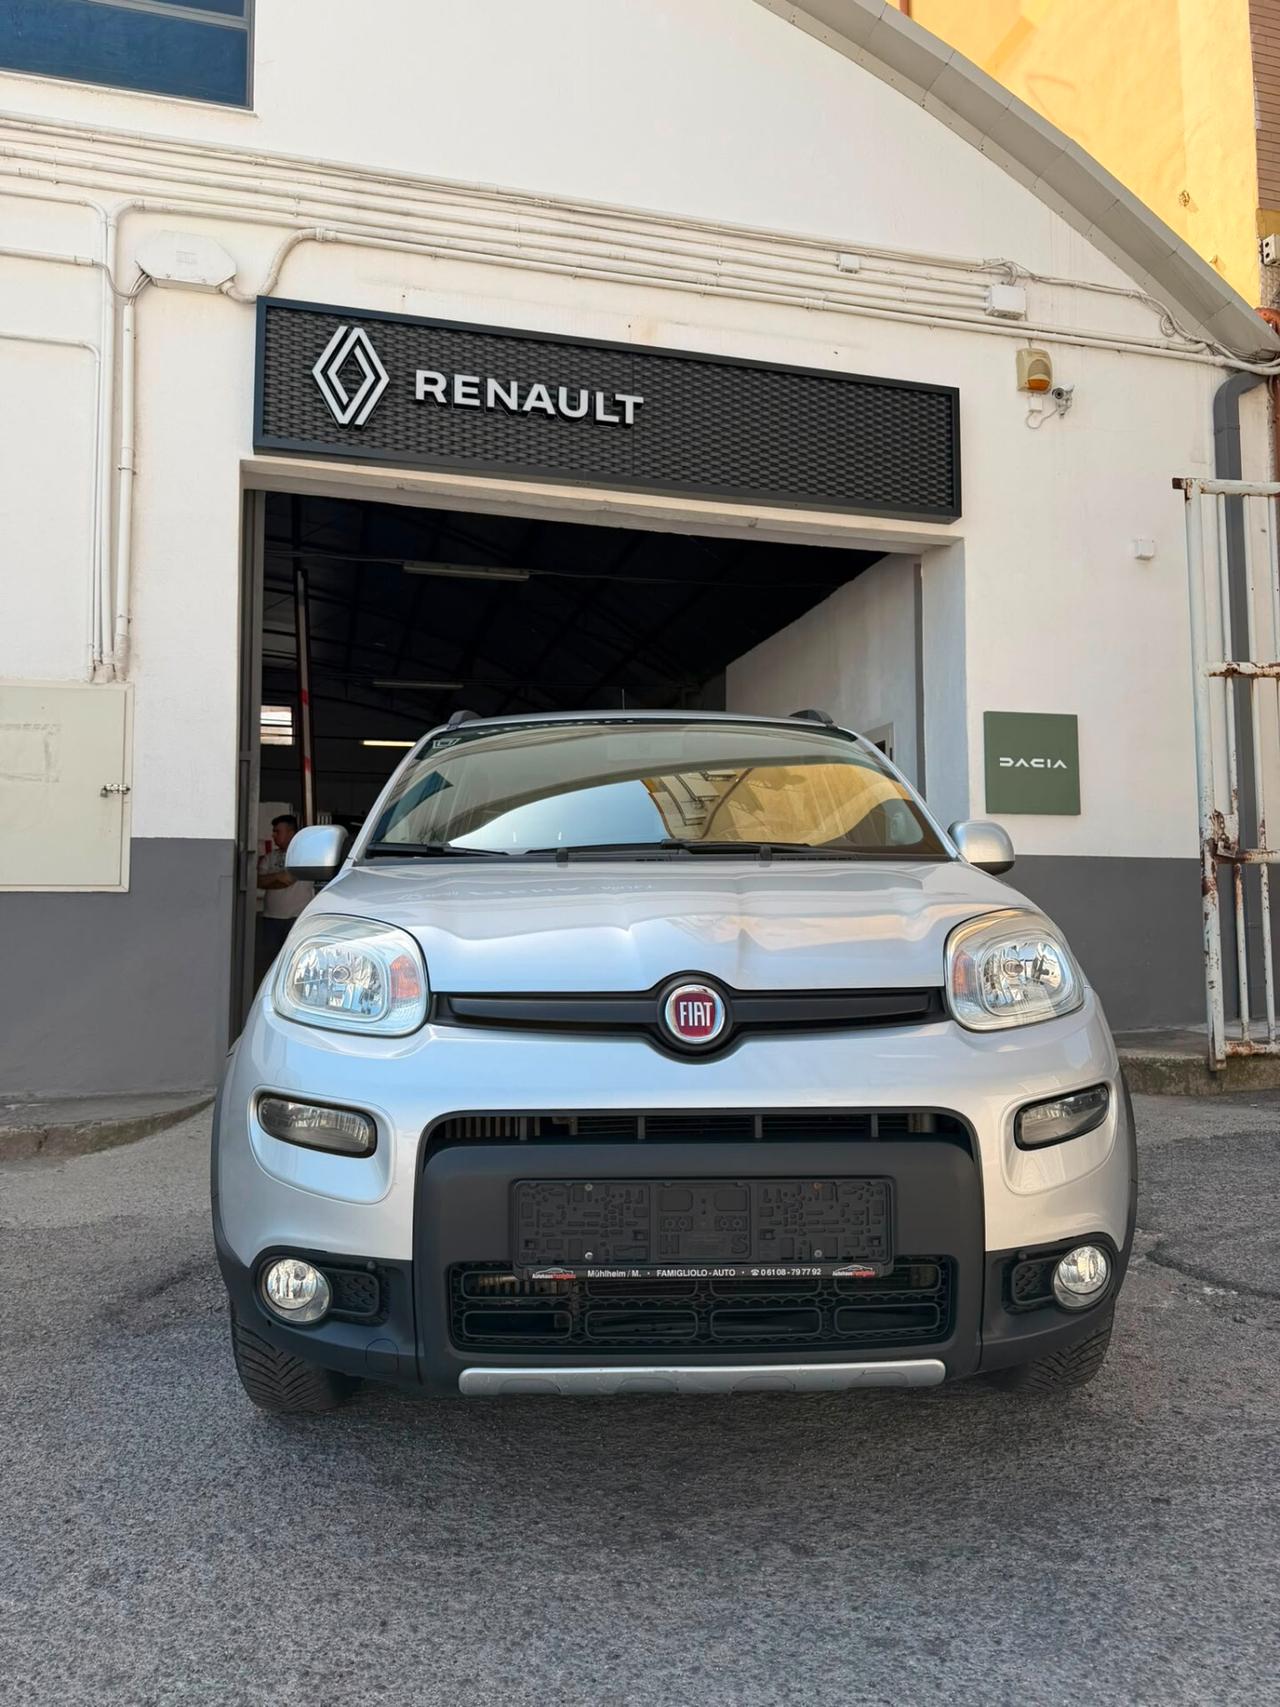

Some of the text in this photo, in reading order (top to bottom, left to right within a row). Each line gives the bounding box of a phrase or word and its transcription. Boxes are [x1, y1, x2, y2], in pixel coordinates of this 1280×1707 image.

[415, 369, 644, 424] RENAULT
[999, 757, 1067, 769] DACIA
[680, 1001, 713, 1027] FIAT
